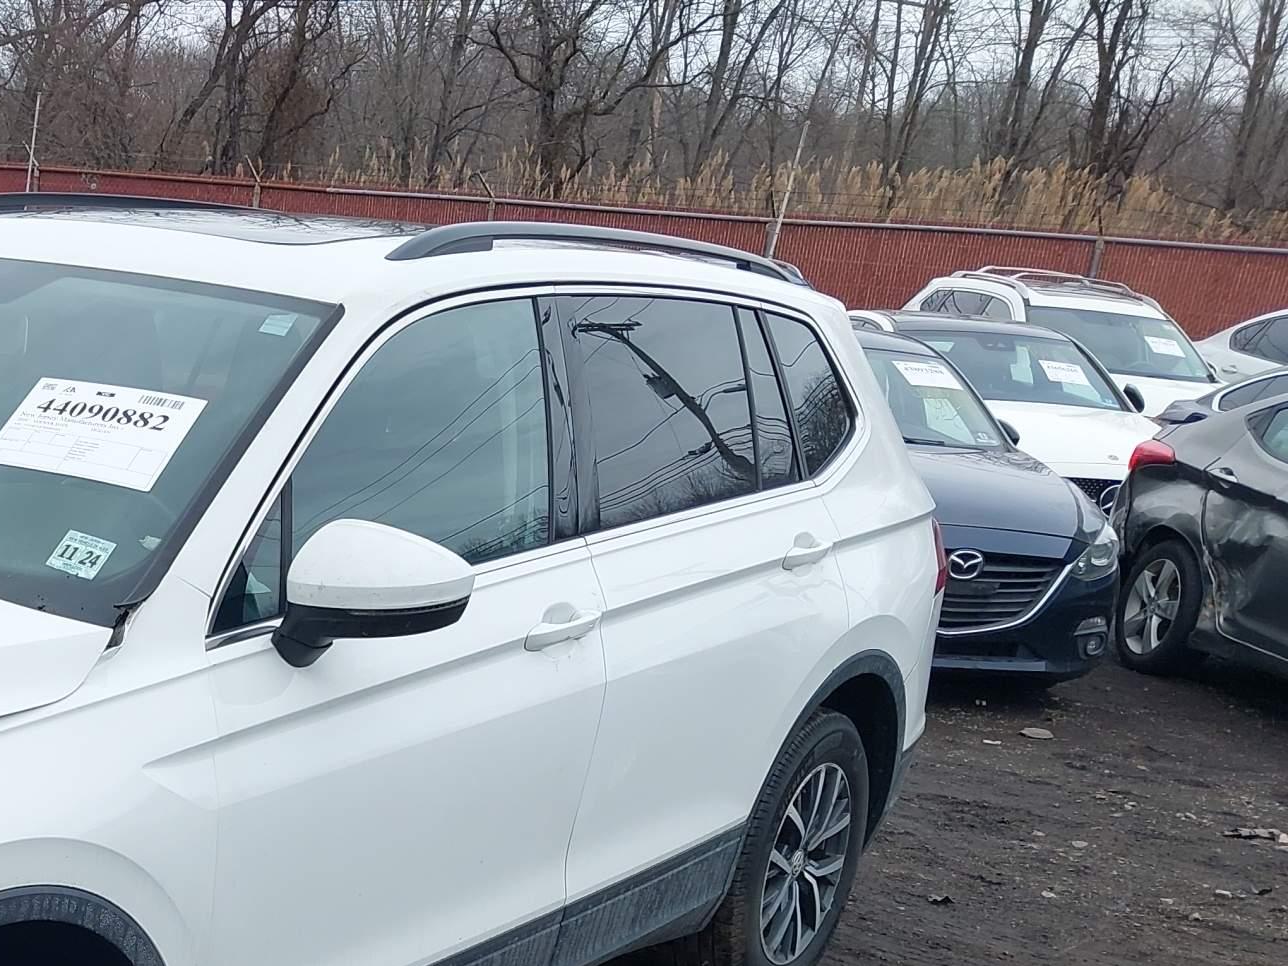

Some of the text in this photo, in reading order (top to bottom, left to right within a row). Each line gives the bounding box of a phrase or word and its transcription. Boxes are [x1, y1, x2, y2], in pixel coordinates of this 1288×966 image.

[36, 398, 170, 432] 44090882
[57, 544, 79, 561] 11
[78, 550, 103, 569] 24
